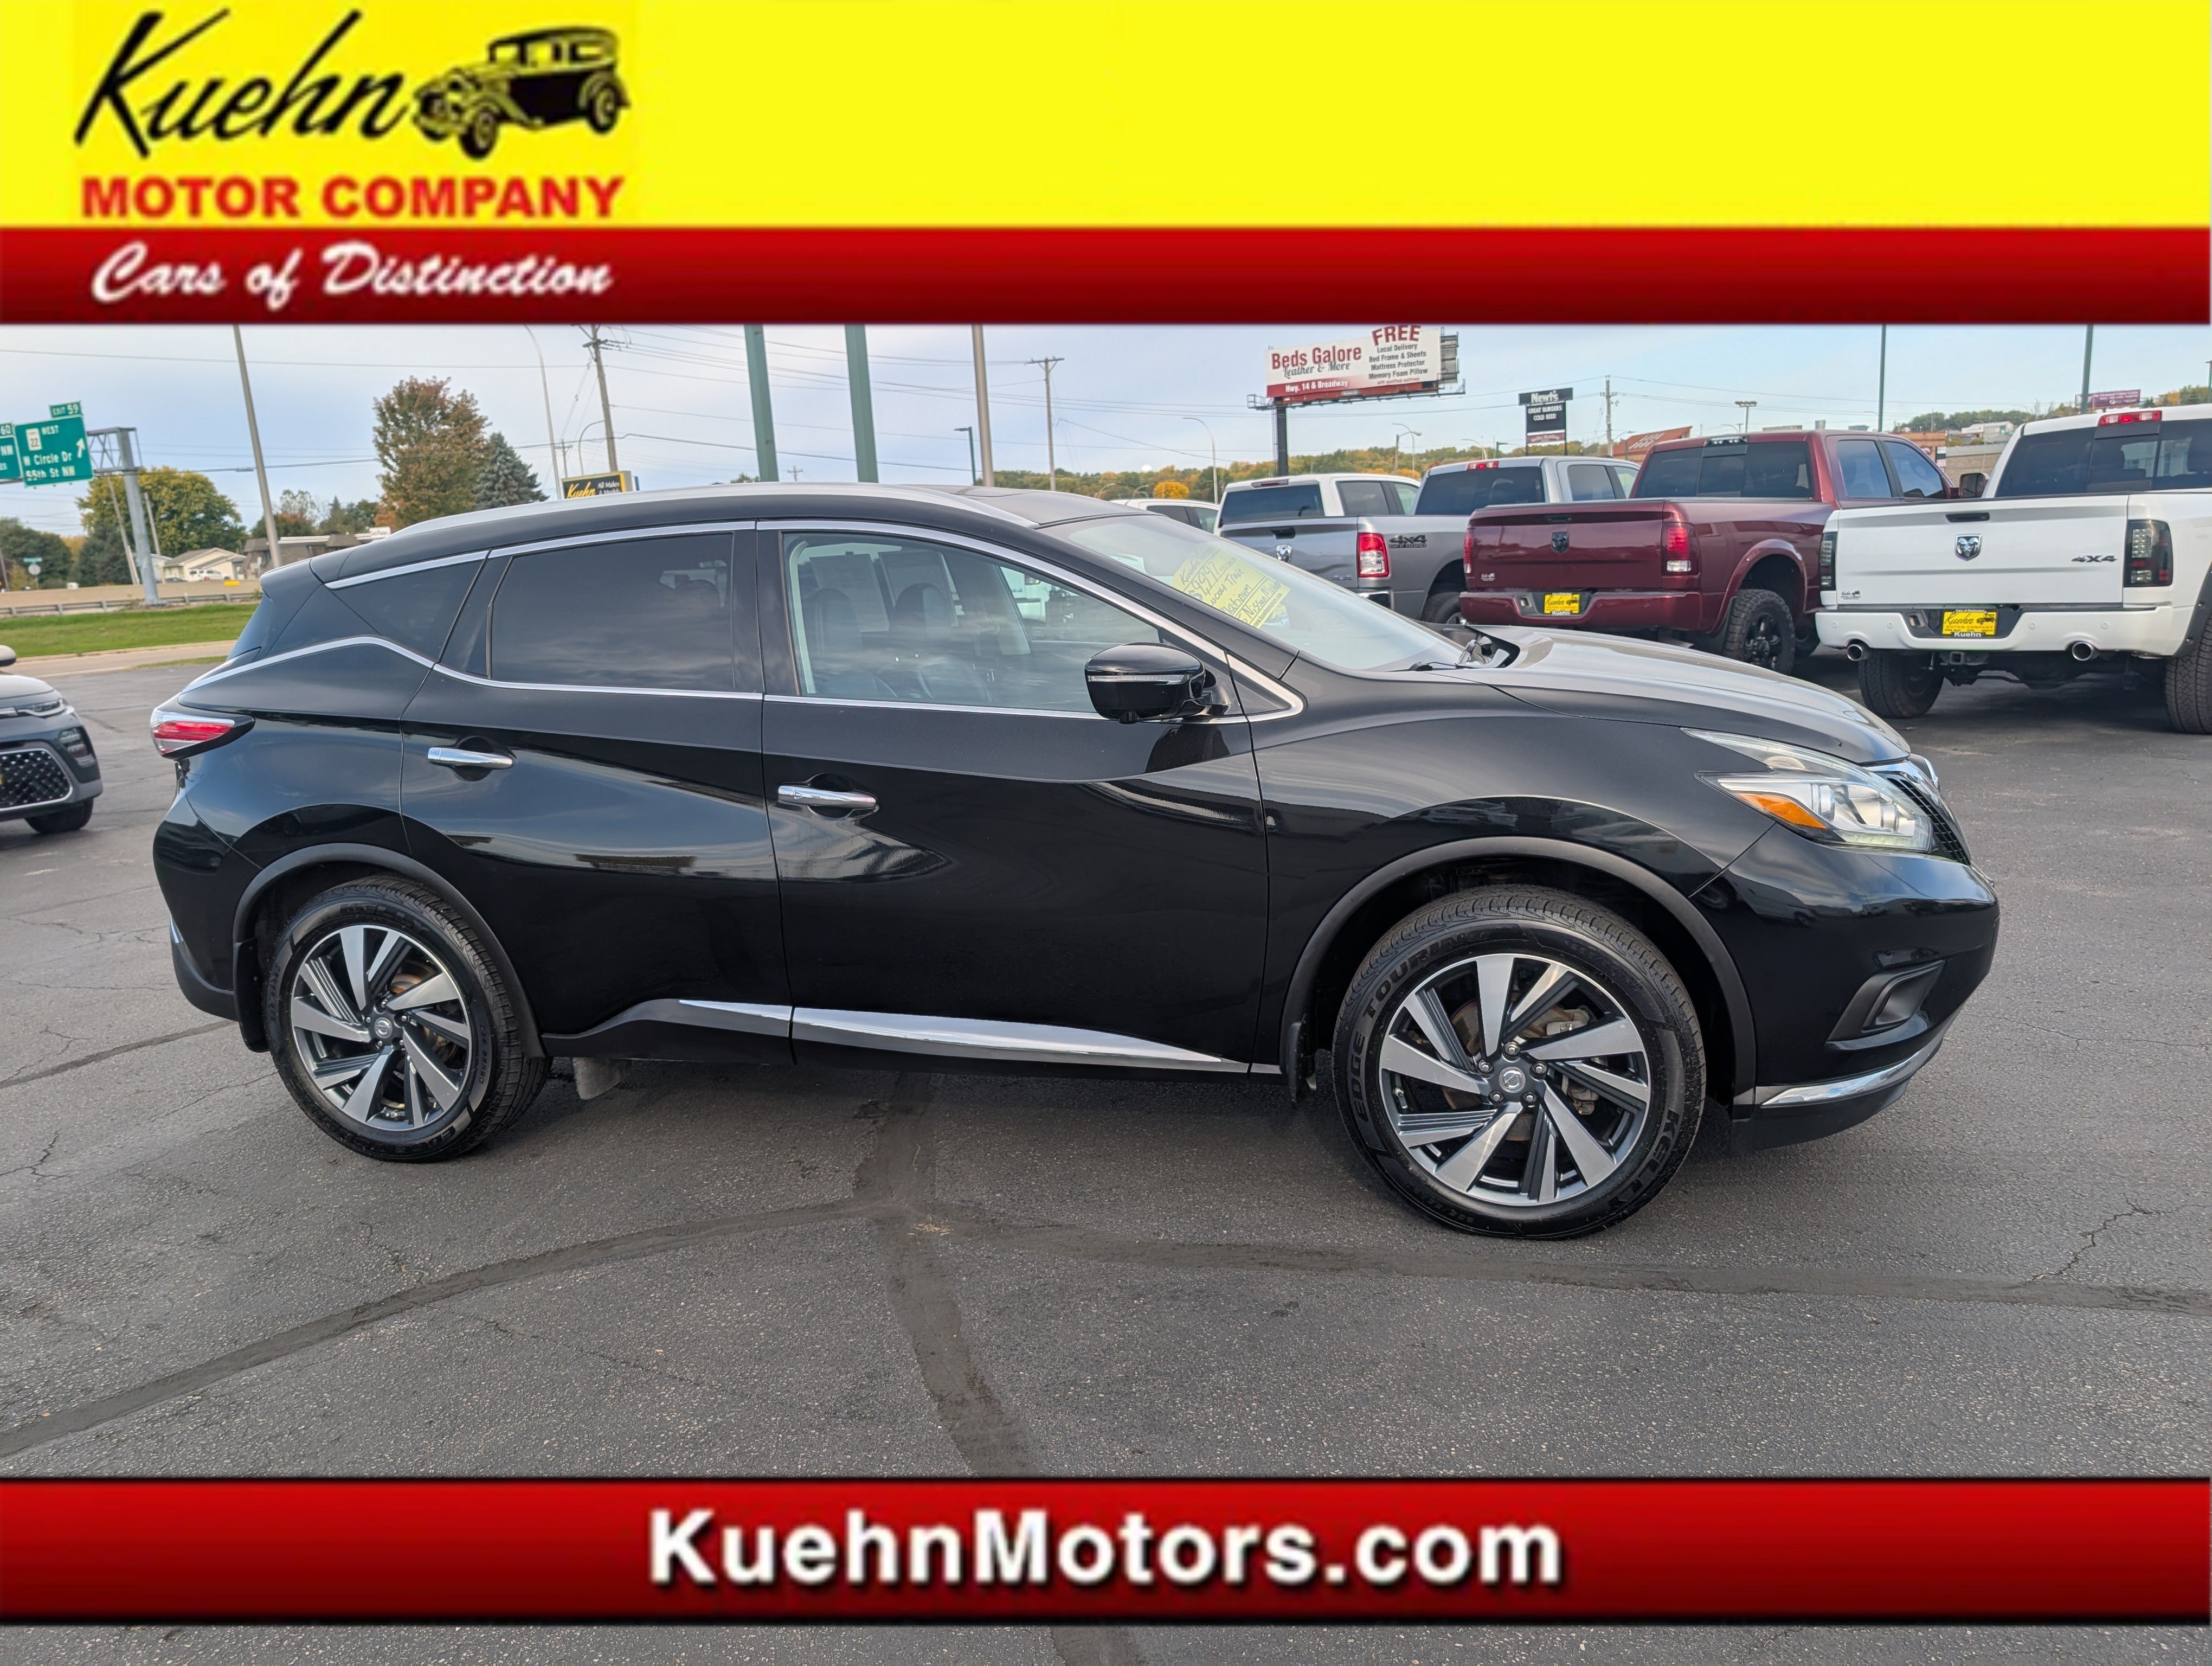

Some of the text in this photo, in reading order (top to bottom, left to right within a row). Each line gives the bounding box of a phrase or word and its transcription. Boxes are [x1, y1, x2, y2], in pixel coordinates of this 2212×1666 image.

[1371, 324, 1421, 346] FREE
[1271, 345, 1361, 370] Beds Galore
[1397, 360, 1425, 368] Protector
[1283, 364, 1315, 379] Leather
[1328, 361, 1350, 371] More
[1285, 384, 1300, 393] Hwy.
[1302, 382, 1309, 390] 14
[1317, 379, 1348, 389] Broadway
[1531, 390, 1558, 403] Newt's
[67, 403, 79, 415] 59
[41, 425, 59, 435] WEST
[30, 437, 39, 447] 22
[34, 453, 59, 466] Circle
[61, 451, 72, 462] Dr
[25, 470, 47, 482] 55th
[49, 467, 60, 478] St
[567, 481, 596, 498] Kuehn
[1210, 584, 1227, 606] ocal
[1944, 612, 1973, 625] Kuehn
[1350, 928, 1491, 1122] EDGE TOURING
[1609, 1109, 1681, 1207] KELLY
